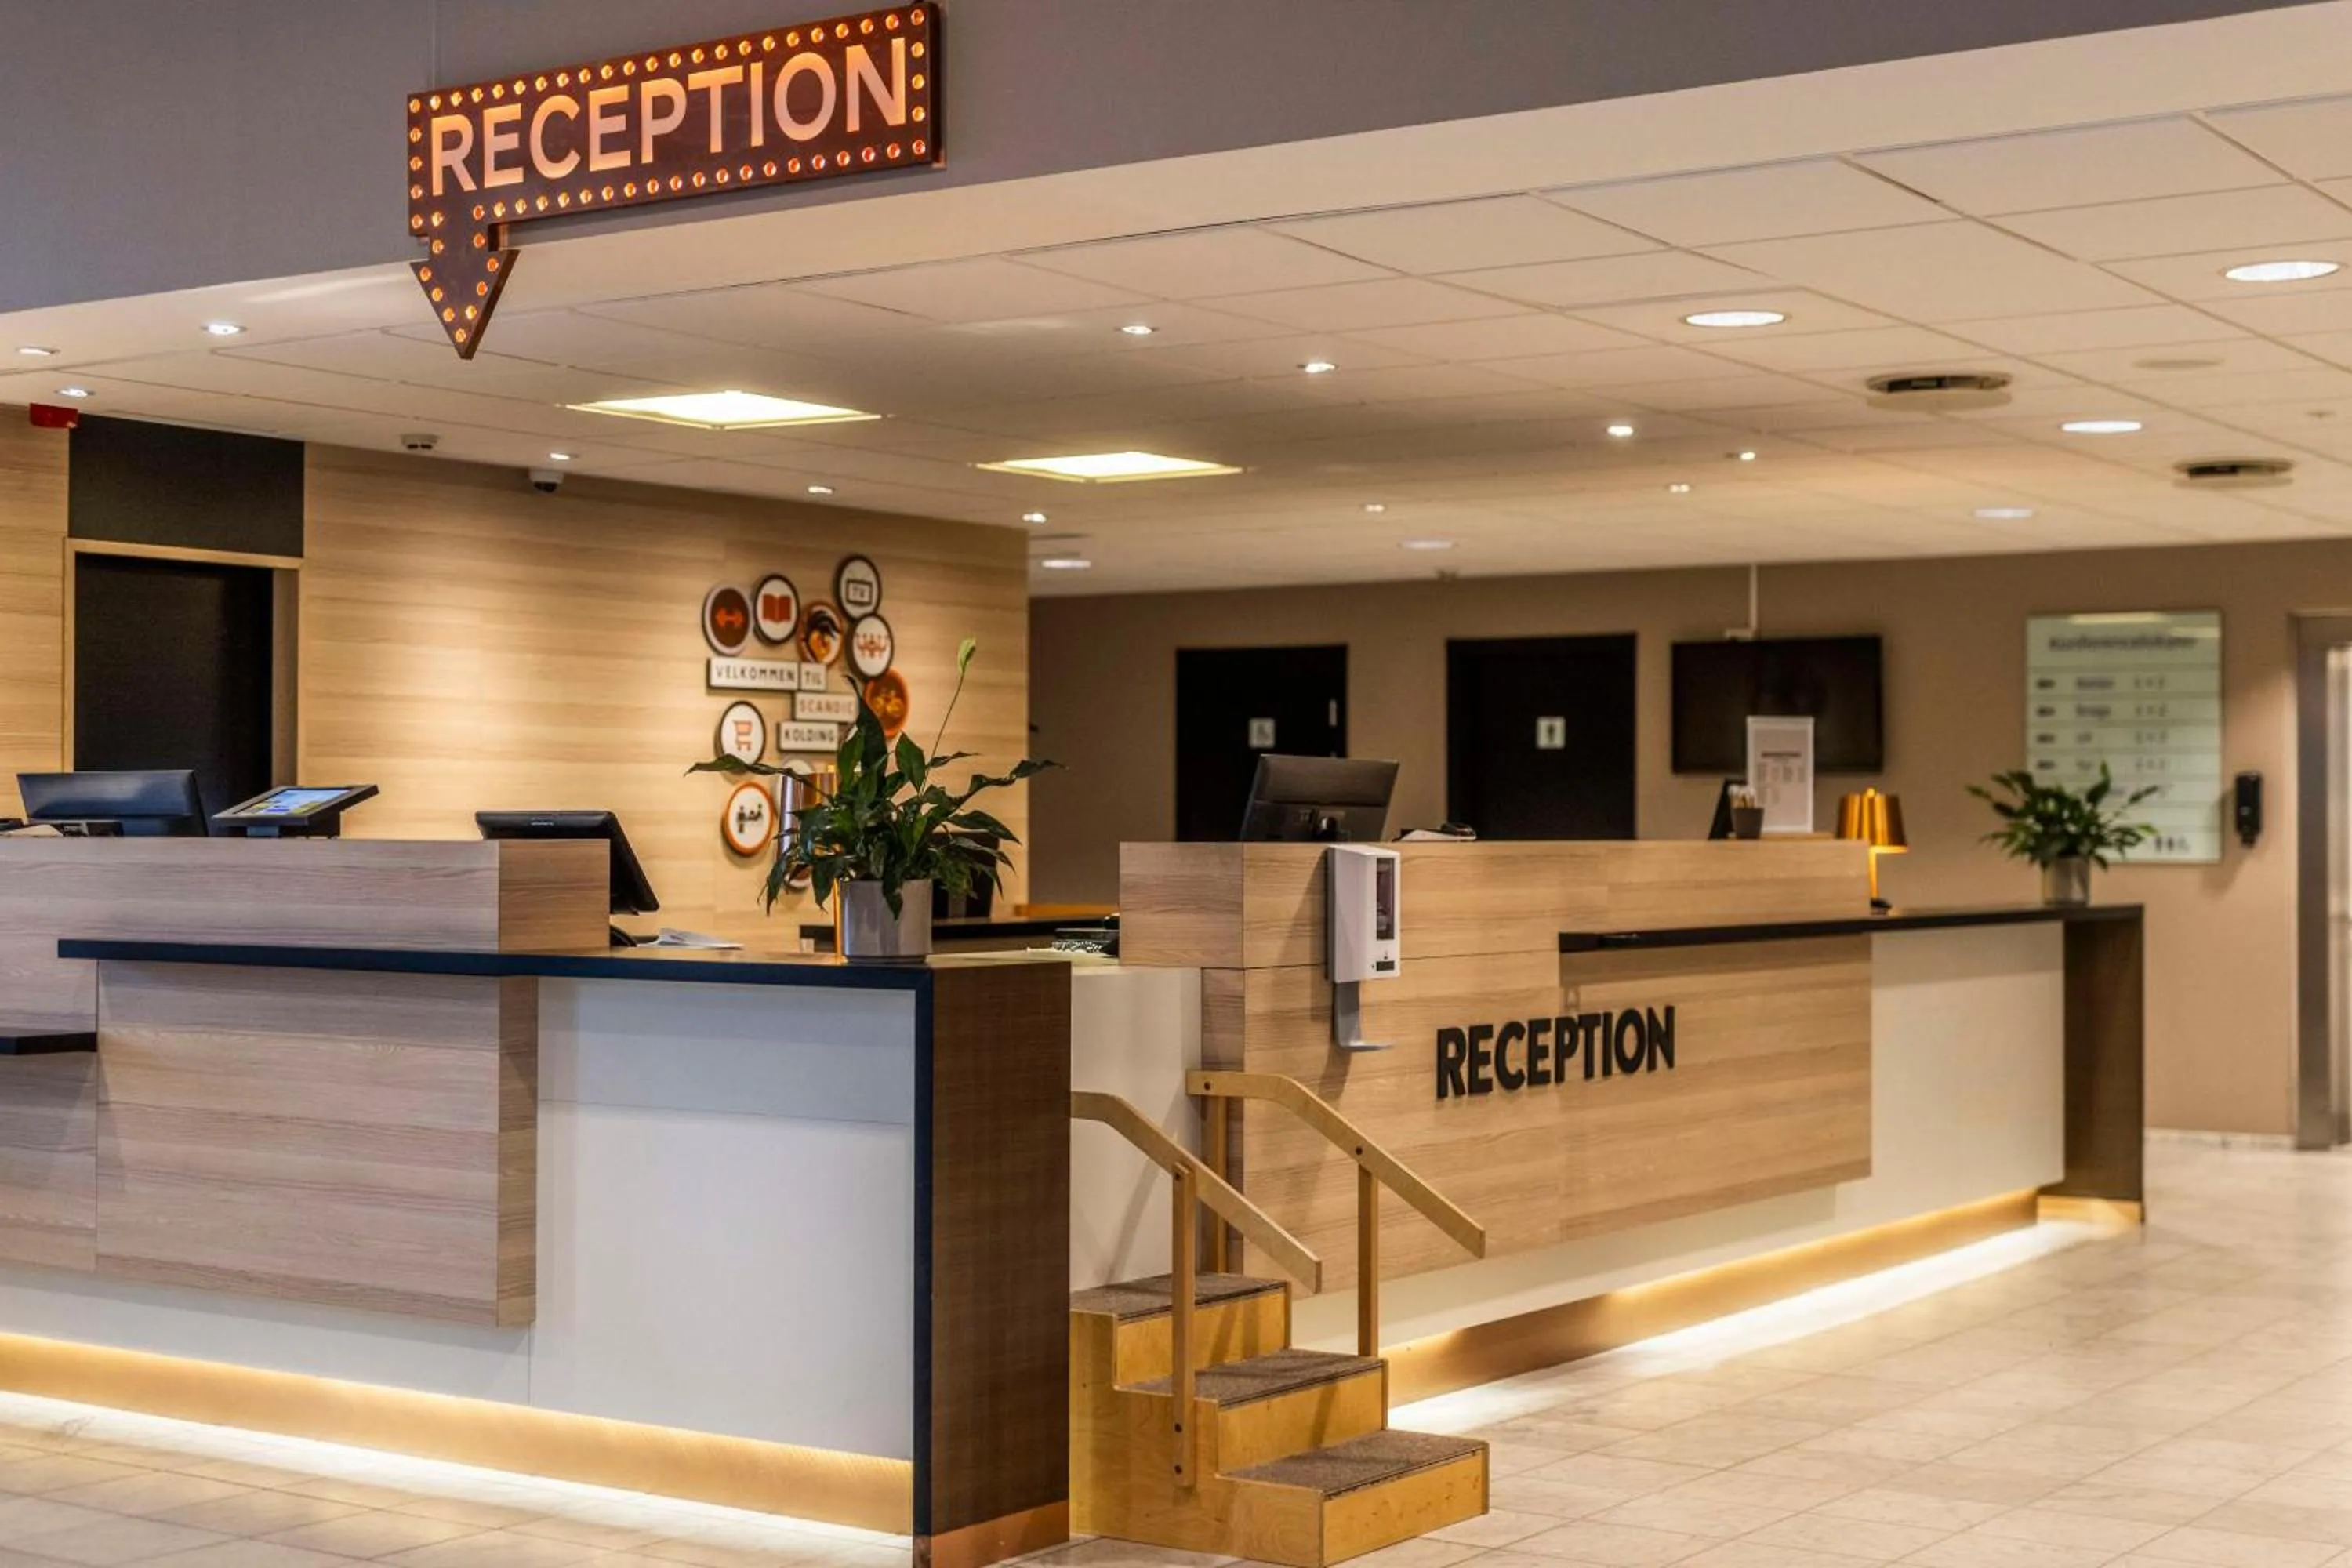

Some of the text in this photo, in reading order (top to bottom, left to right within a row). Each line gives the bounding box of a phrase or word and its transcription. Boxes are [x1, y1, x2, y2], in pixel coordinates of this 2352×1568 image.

[432, 38, 905, 195] RECEPTION
[716, 665, 822, 685] VELKOMMEN TIL
[800, 701, 855, 715] SCANDIC
[785, 729, 835, 742] KOLDING
[1437, 1005, 1675, 1099] RECEPTION
